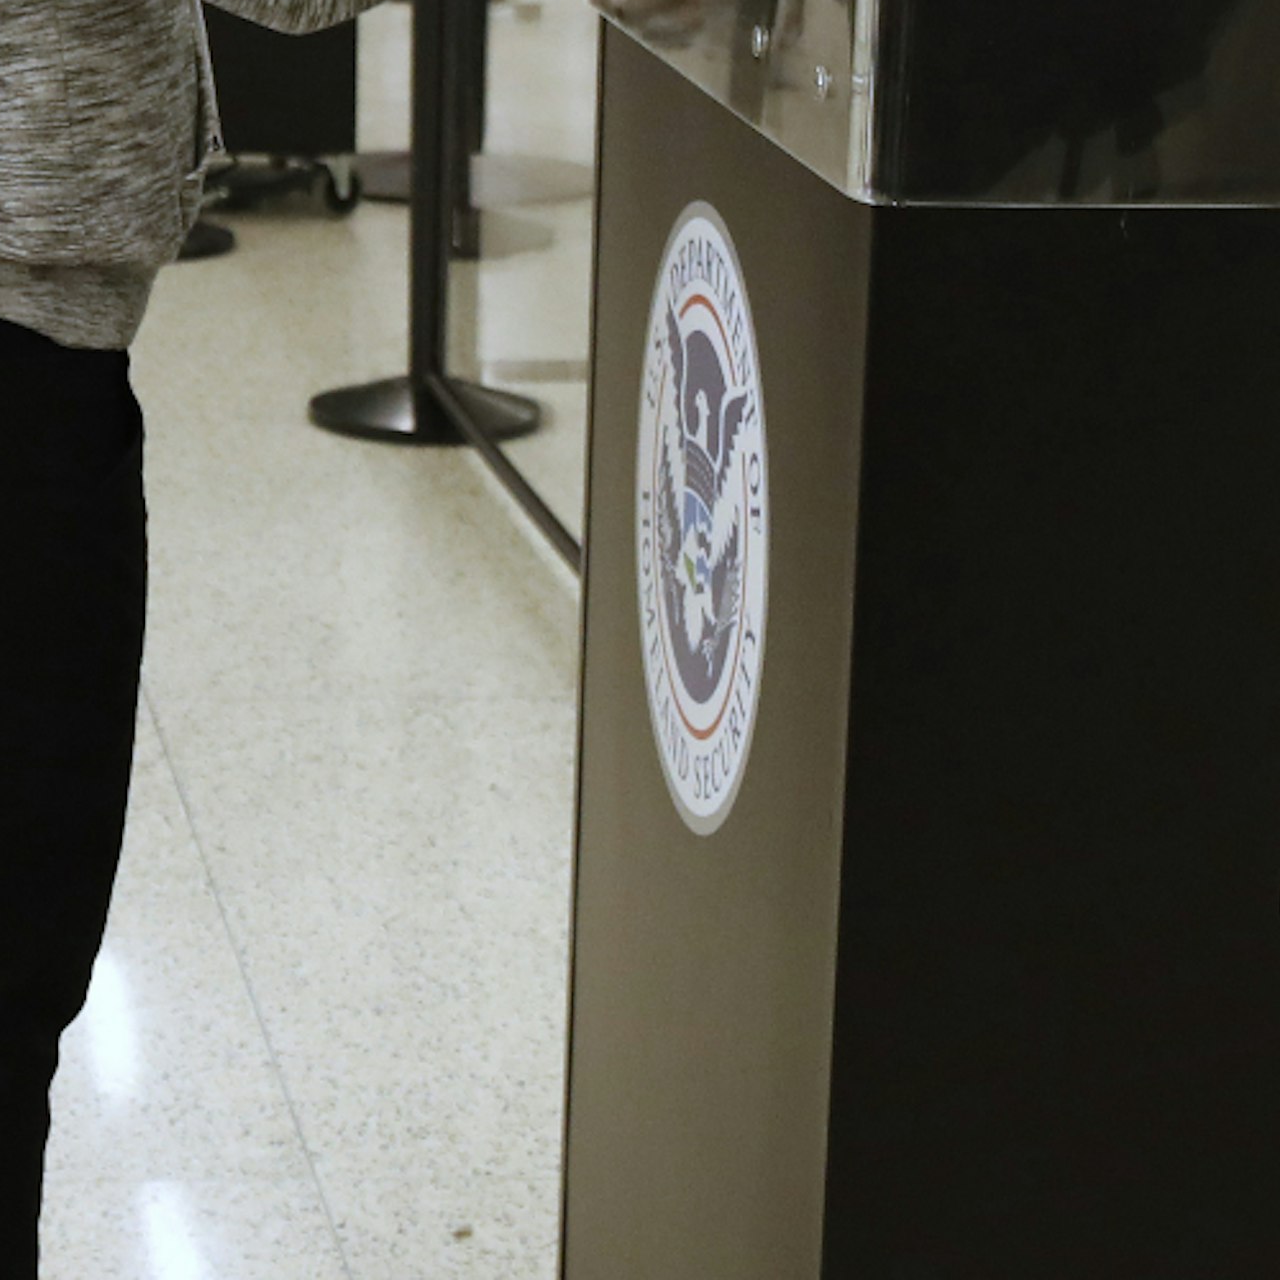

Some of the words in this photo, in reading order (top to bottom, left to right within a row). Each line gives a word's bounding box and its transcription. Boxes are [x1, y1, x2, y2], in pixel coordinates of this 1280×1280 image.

[670, 235, 757, 426] DEPARTMENT
[749, 452, 762, 536] OF
[693, 616, 756, 800] SECURITY
